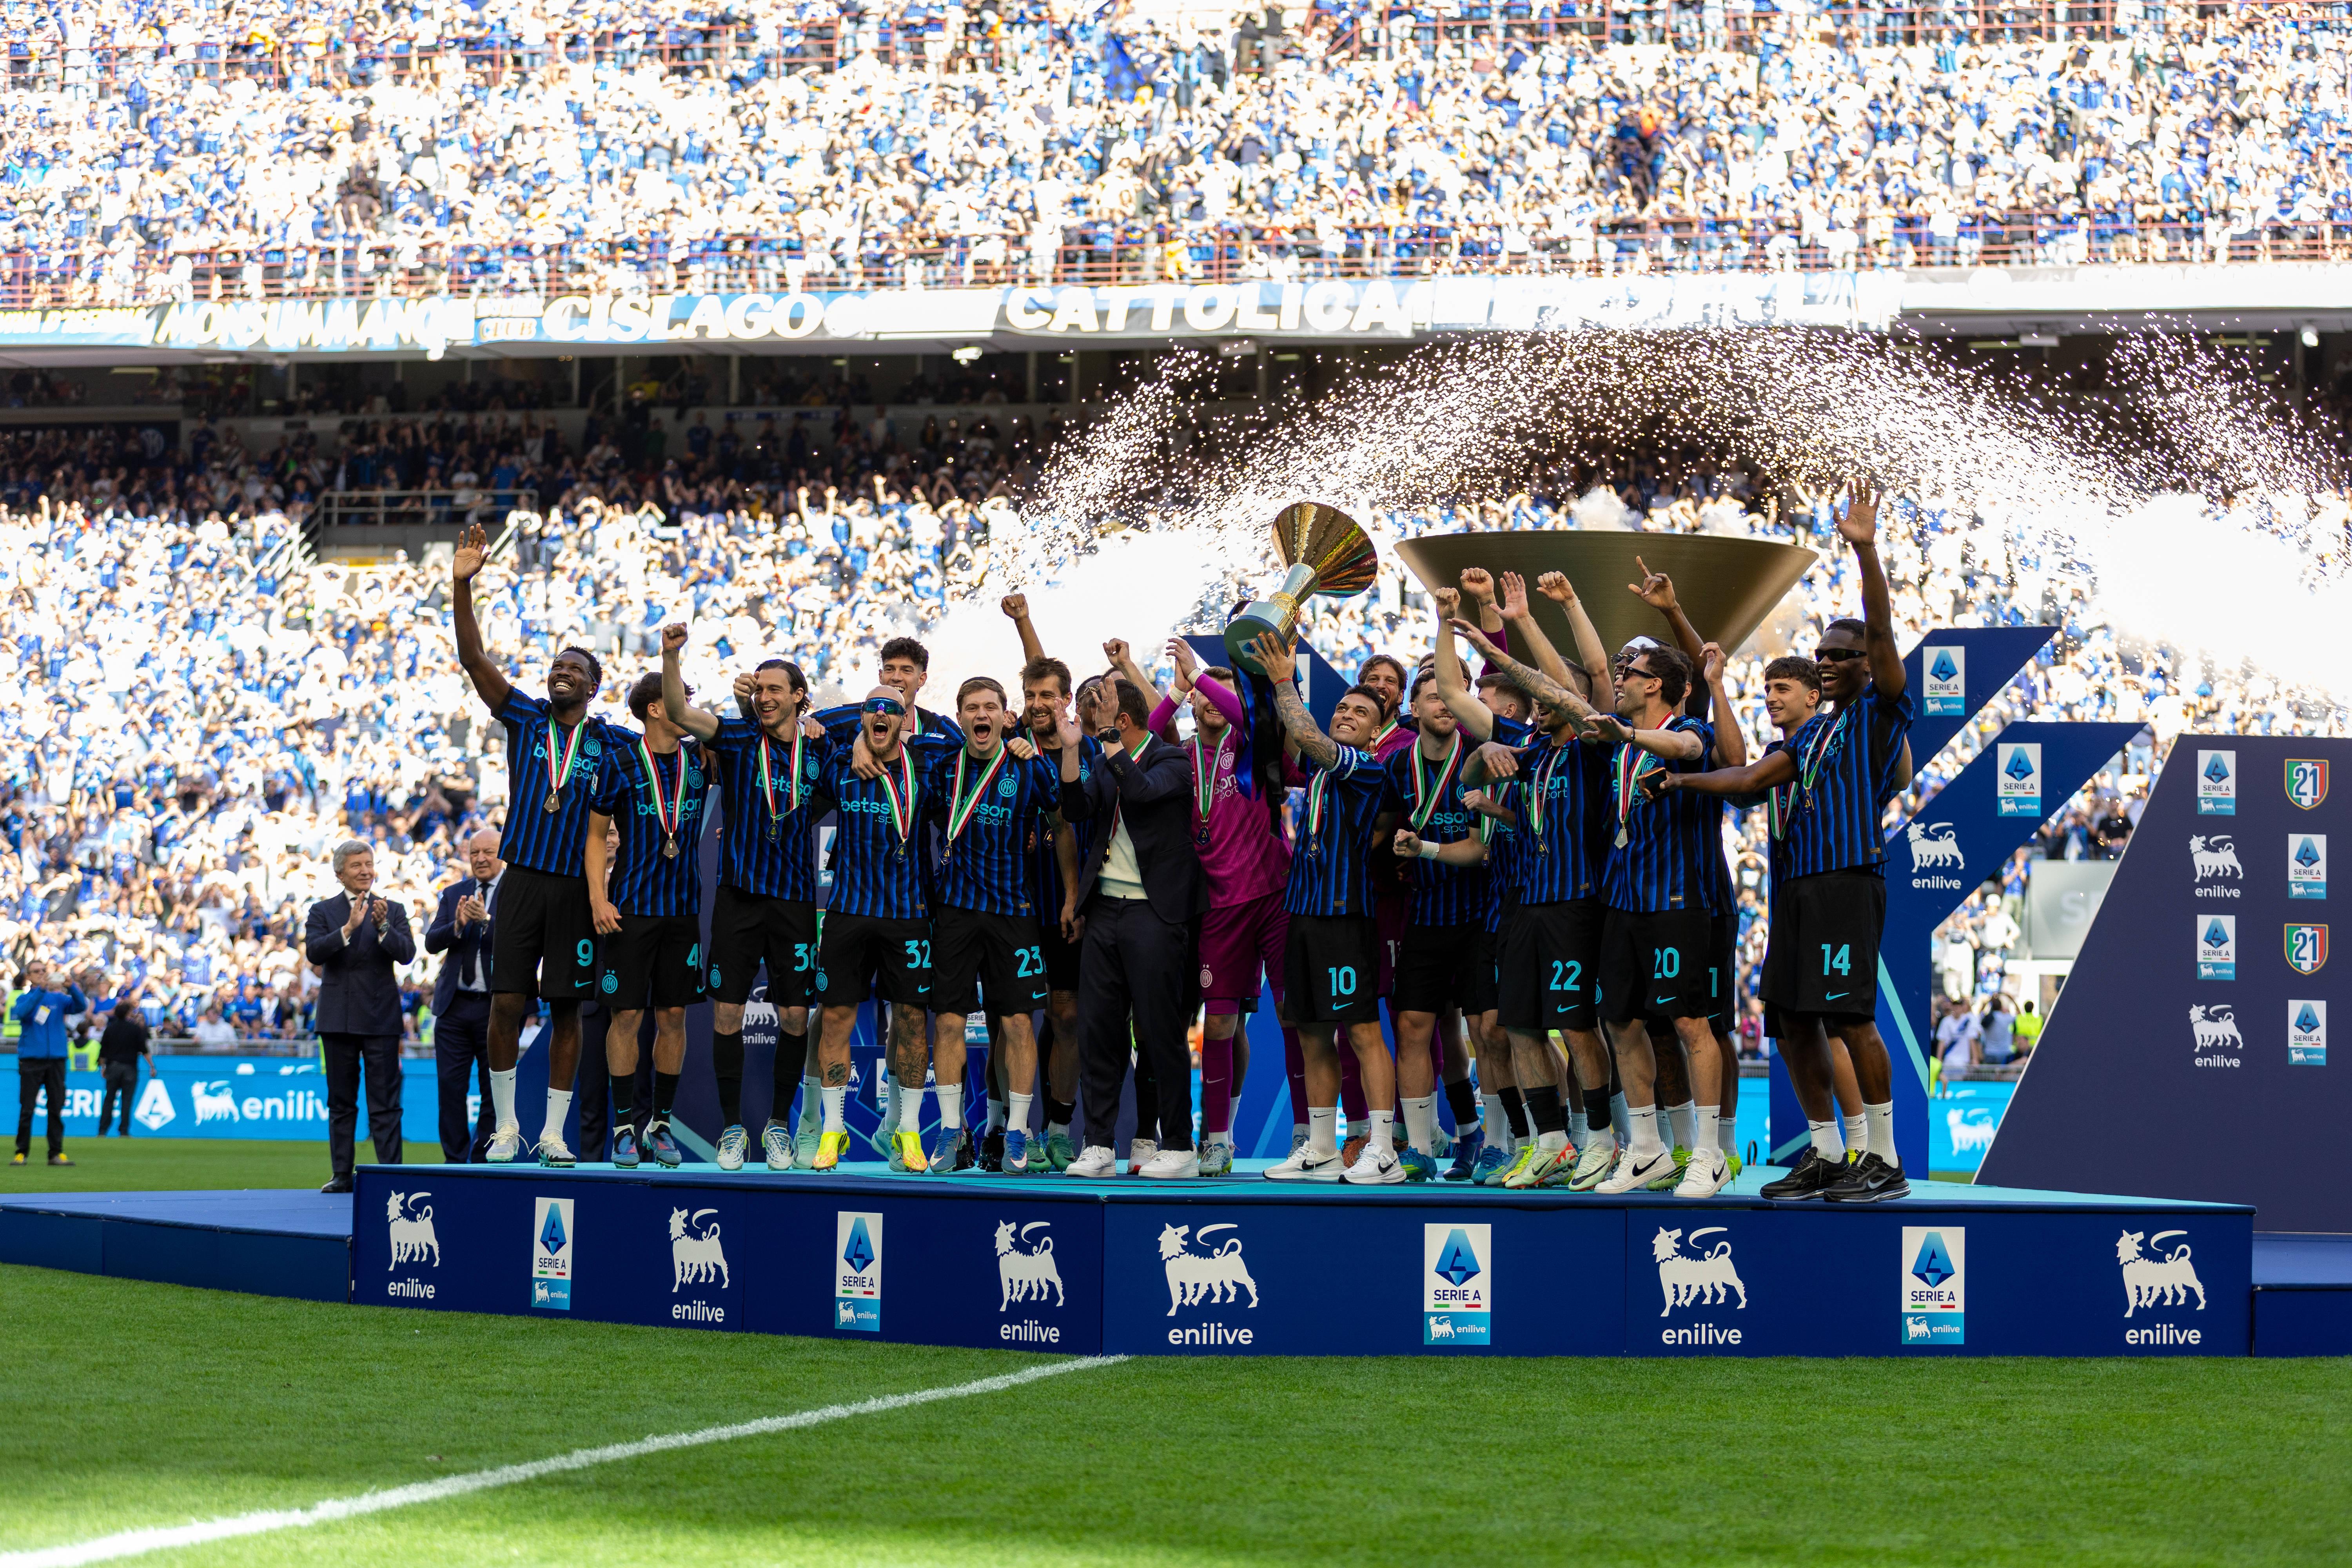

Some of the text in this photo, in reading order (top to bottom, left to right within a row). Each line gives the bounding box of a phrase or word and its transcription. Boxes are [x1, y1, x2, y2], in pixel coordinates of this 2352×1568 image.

[542, 292, 825, 342] CISLAGO
[1005, 279, 1404, 332] CATTOLICA
[155, 297, 447, 348] MONSUMMANO
[2294, 767, 2318, 797] 21
[1912, 876, 1962, 889] enilive
[2195, 885, 2241, 898] enilive
[577, 938, 593, 967] 9
[687, 943, 702, 971] 4
[905, 940, 931, 969] 32
[1388, 940, 1401, 967] 1
[2293, 931, 2318, 962] 21
[1014, 946, 1044, 978] 23
[1654, 947, 1680, 978] 20
[1821, 944, 1851, 976] 14
[1328, 966, 1356, 996] 10
[1550, 960, 1582, 991] 22
[742, 1033, 777, 1044] enilive
[2194, 1054, 2241, 1068] enilive
[241, 1089, 329, 1121] eniliv
[538, 1257, 566, 1269] SERIE A
[388, 1278, 436, 1299] enilive
[842, 1275, 875, 1288] SERIE A
[550, 1290, 568, 1299] enilive
[1433, 1289, 1481, 1301] SERIE A
[1910, 1290, 1956, 1302] SERIE A
[672, 1300, 724, 1323] enilive
[857, 1311, 877, 1320] enilive
[1000, 1319, 1060, 1343] enilive
[1168, 1322, 1254, 1345] enilive
[1456, 1325, 1486, 1334] enilive
[1662, 1323, 1742, 1345] enilive
[1932, 1325, 1960, 1334] enilive
[2125, 1323, 2202, 1345] enilive
